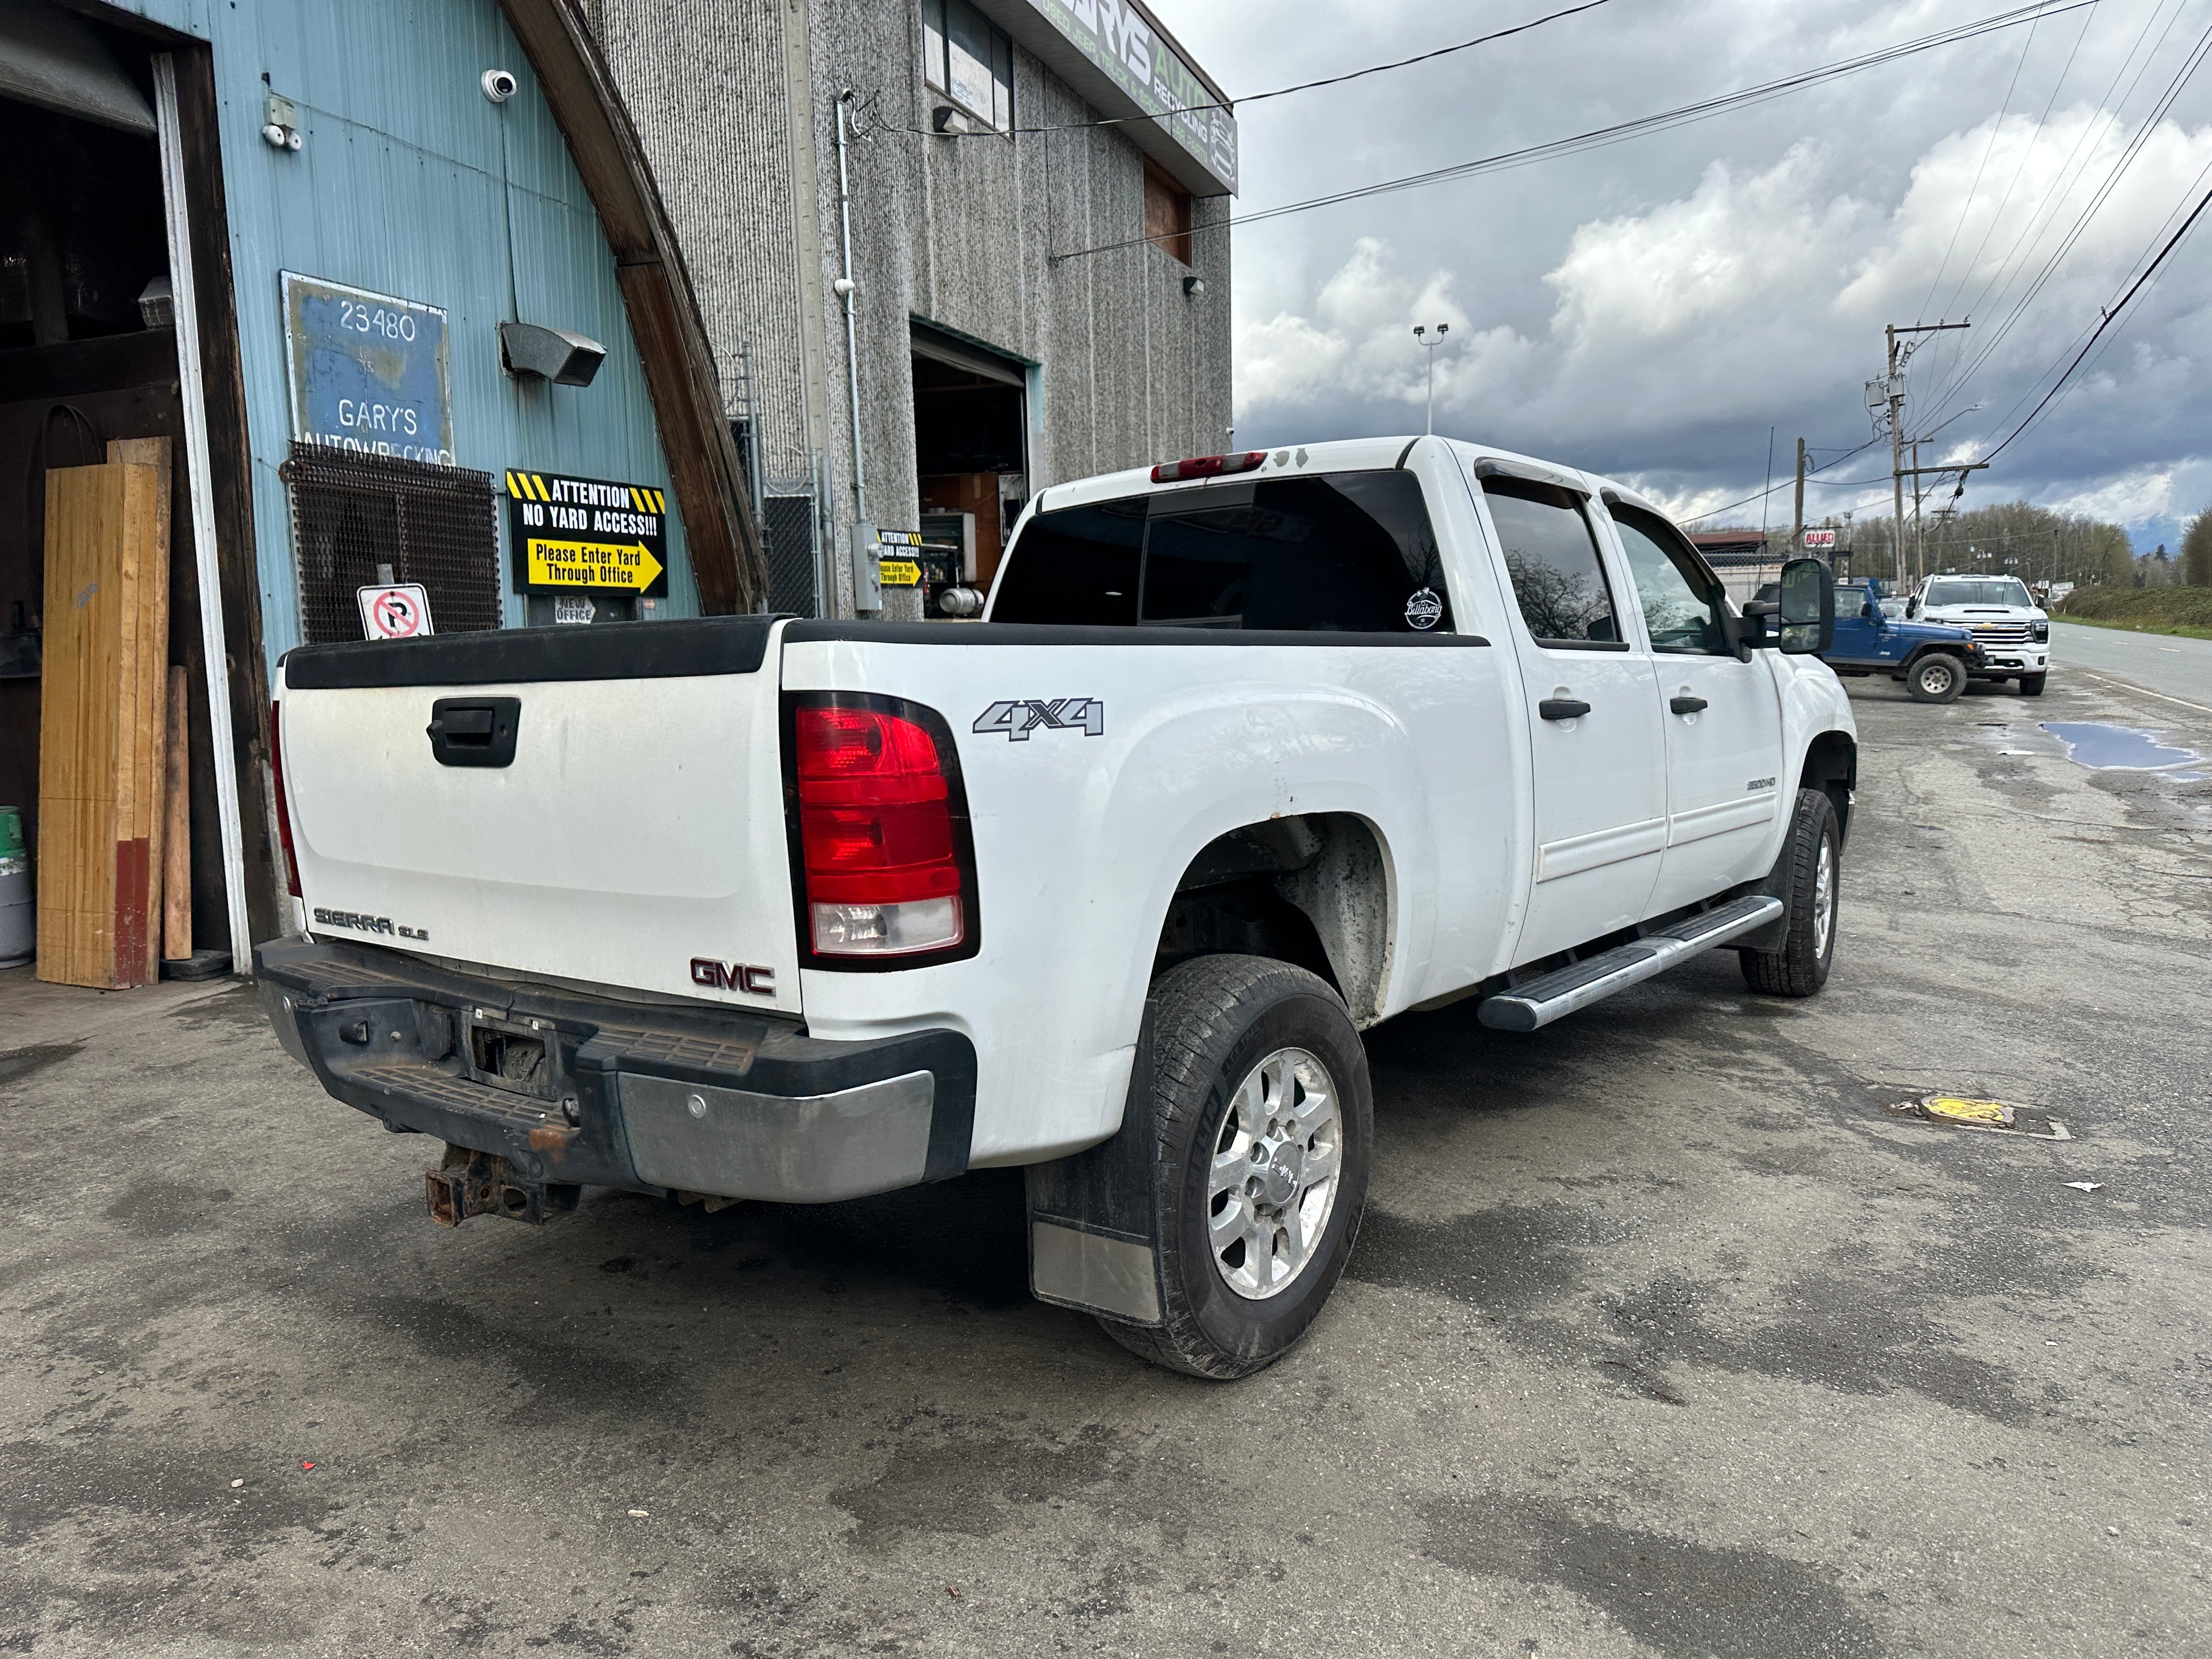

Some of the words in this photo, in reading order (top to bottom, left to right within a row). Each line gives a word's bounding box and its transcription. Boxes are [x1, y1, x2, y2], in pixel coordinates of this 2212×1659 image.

[1043, 0, 1069, 32] USED
[1100, 50, 1128, 89] TRUCK
[1139, 89, 1168, 126] SPORTS
[1172, 118, 1185, 142] CAR
[1187, 135, 1208, 164] PARTS
[1154, 44, 1207, 123] AUTO
[1154, 76, 1207, 143] RECYCLING
[340, 300, 415, 342] 23480
[339, 399, 417, 435] GARY'S
[552, 479, 630, 509] ATTENTION
[522, 503, 544, 527] NO
[549, 506, 588, 530] YARD
[594, 511, 657, 536] ACCESS!!!
[881, 531, 909, 544] ATTENTION
[1805, 533, 1834, 543] ALLIED
[536, 543, 576, 562] Please
[581, 547, 612, 565] Enter
[616, 550, 641, 566] Yard
[884, 545, 895, 556] ARD
[547, 563, 595, 584] Through
[600, 566, 633, 583] Office
[879, 563, 891, 572] lease
[892, 564, 903, 572] Enter
[904, 565, 914, 573] Yard
[881, 573, 897, 582] Through
[899, 573, 911, 581] Office
[560, 597, 585, 608] NEW
[1404, 601, 1442, 619] Billabong
[556, 608, 592, 621] OFFICE
[314, 907, 395, 935] SIERRA
[398, 925, 429, 941] SLE
[690, 957, 777, 997] GMC
